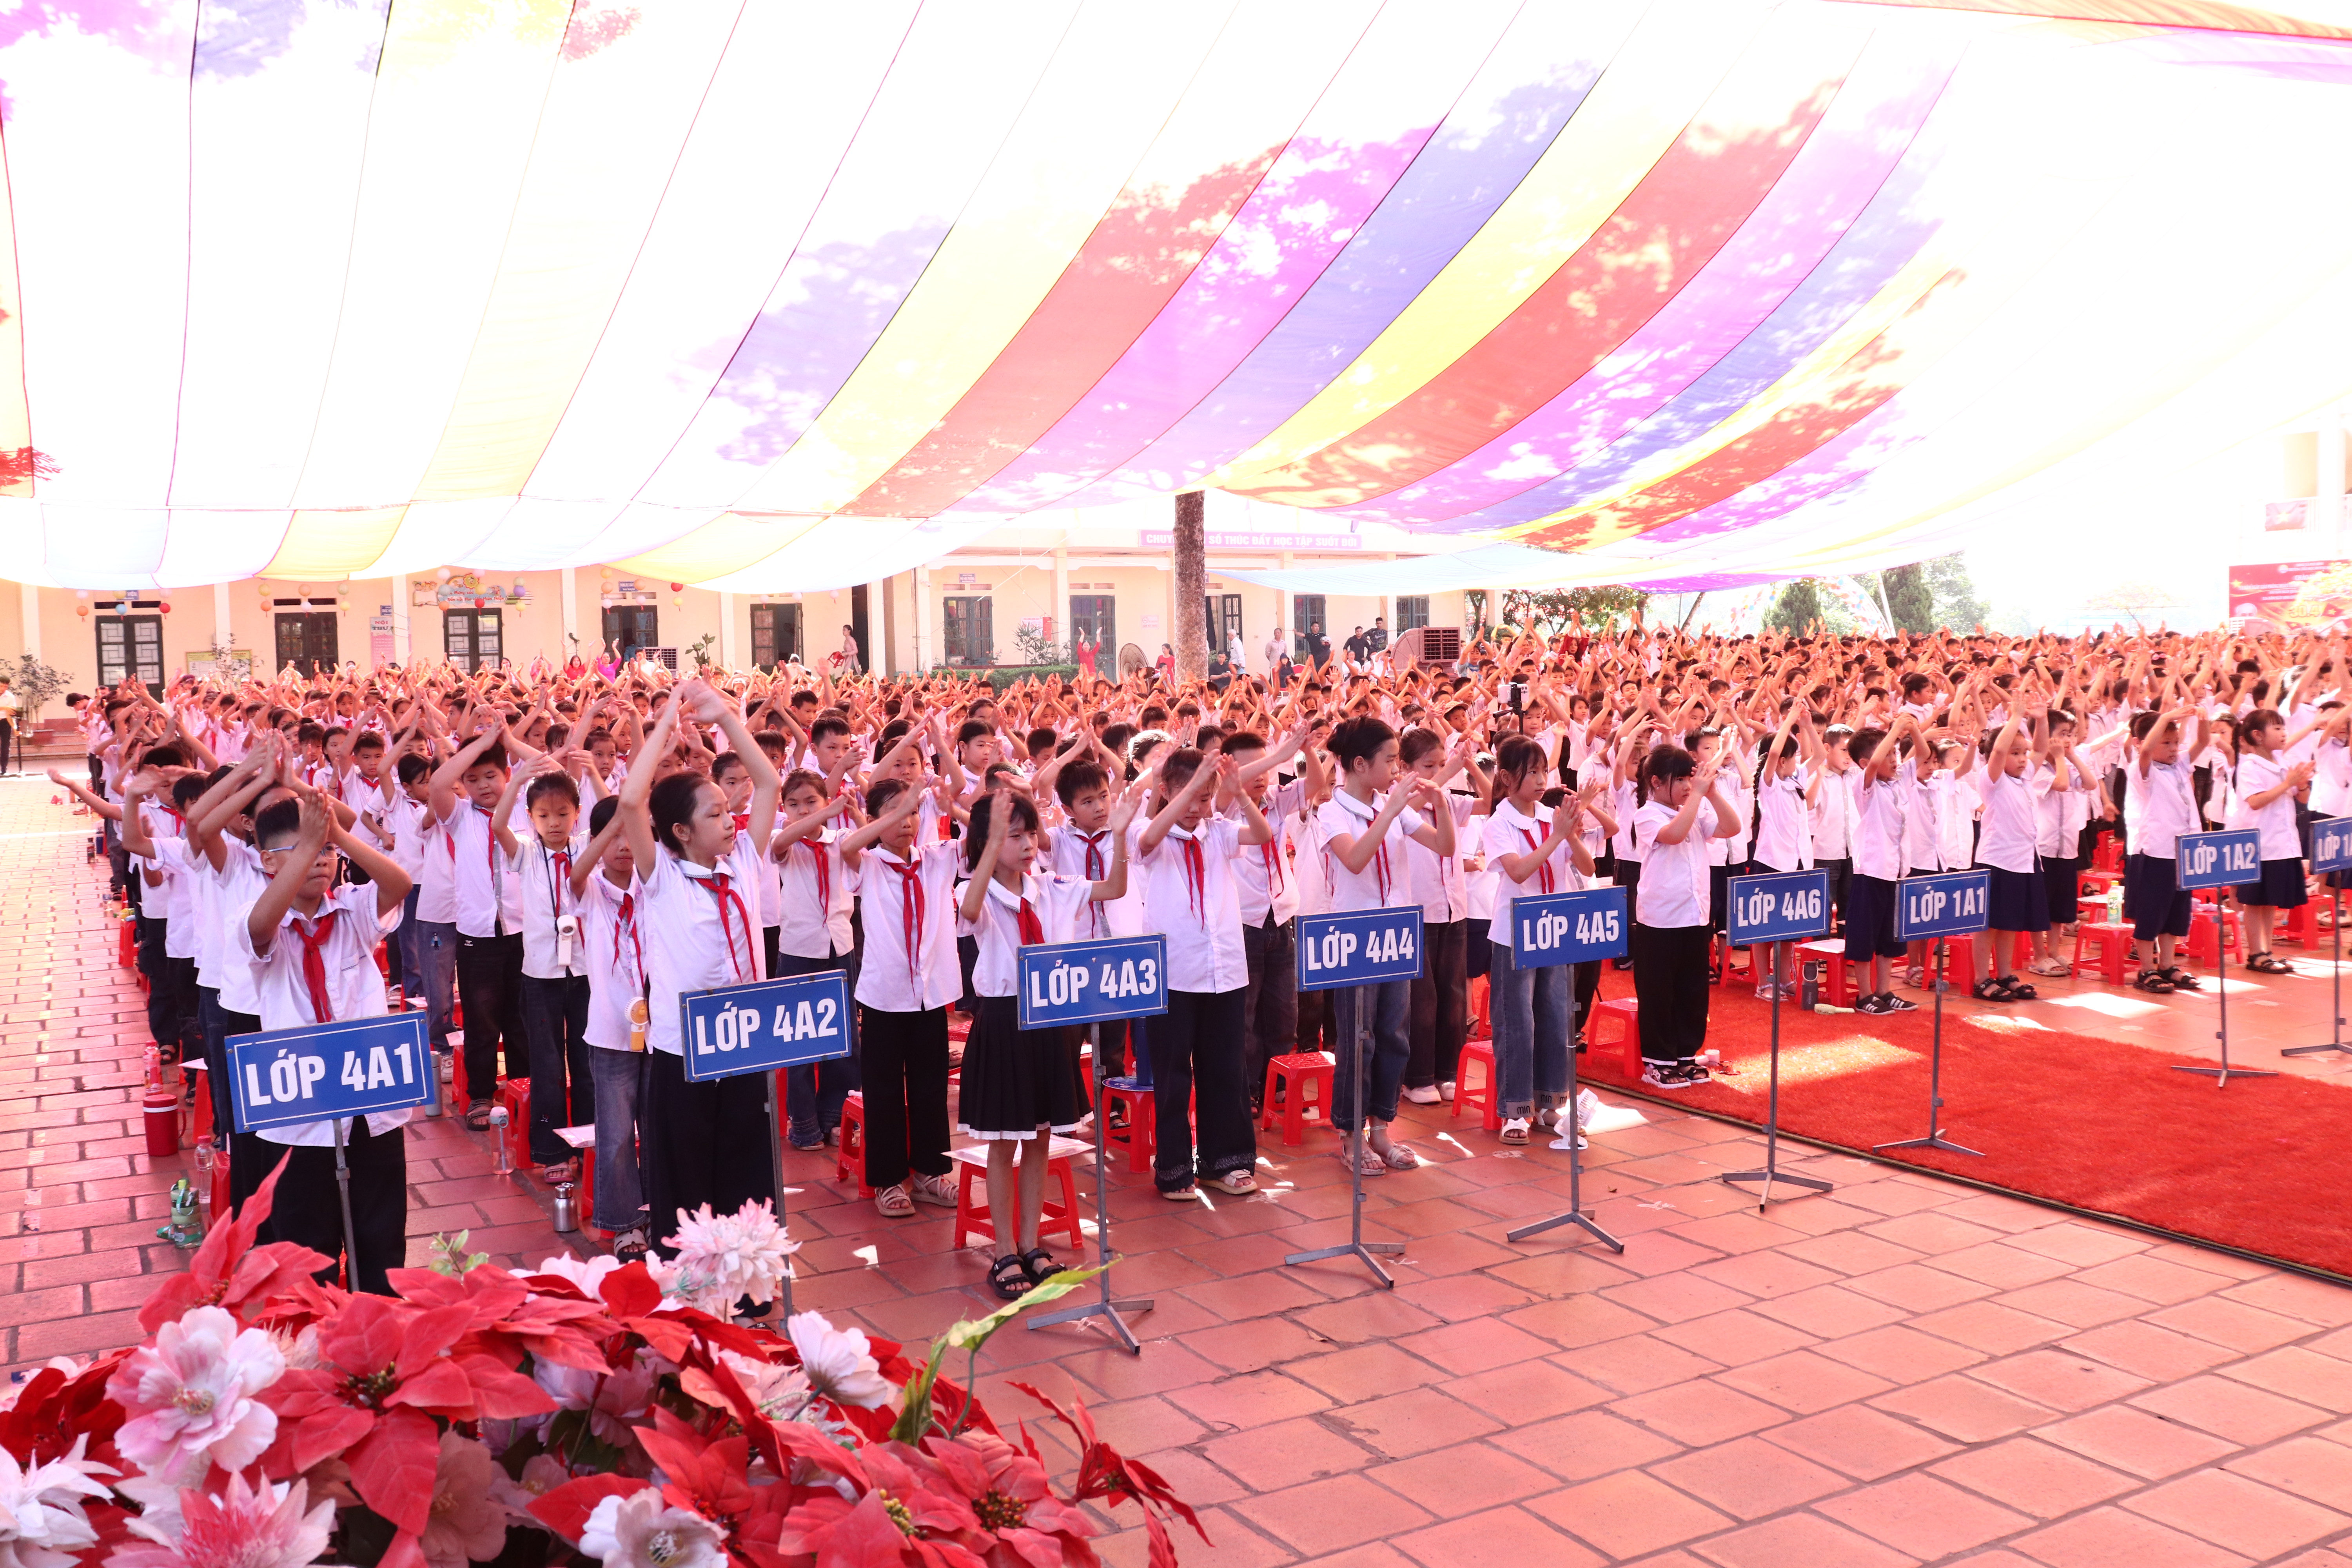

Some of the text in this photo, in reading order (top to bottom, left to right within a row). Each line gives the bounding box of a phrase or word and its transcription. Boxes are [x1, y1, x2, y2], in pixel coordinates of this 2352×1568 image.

[1146, 534, 1175, 544] CHUY
[1209, 533, 1222, 544] SỐ
[1225, 534, 1249, 544] THÚC
[1252, 533, 1271, 545] ĐẨY
[1274, 537, 1292, 547] HỌC
[1295, 535, 1313, 548] TẬP
[1316, 535, 1339, 546] SUỐT
[1341, 536, 1357, 547] ĐỜI
[2288, 605, 2320, 618] 30.4
[2185, 840, 2256, 875] LỚP 1A2
[2318, 831, 2340, 862] LỚP
[1737, 887, 1821, 927] LỚP 4A6
[1910, 886, 1985, 924] LỚP 1A1
[1307, 926, 1414, 971] LỚP 4A4
[1523, 909, 1619, 951] LỚP 4A5
[1031, 958, 1157, 1007] LỚP 4A3
[695, 998, 838, 1055] LỚP 4A2
[245, 1043, 414, 1107] LỚP 4A1
